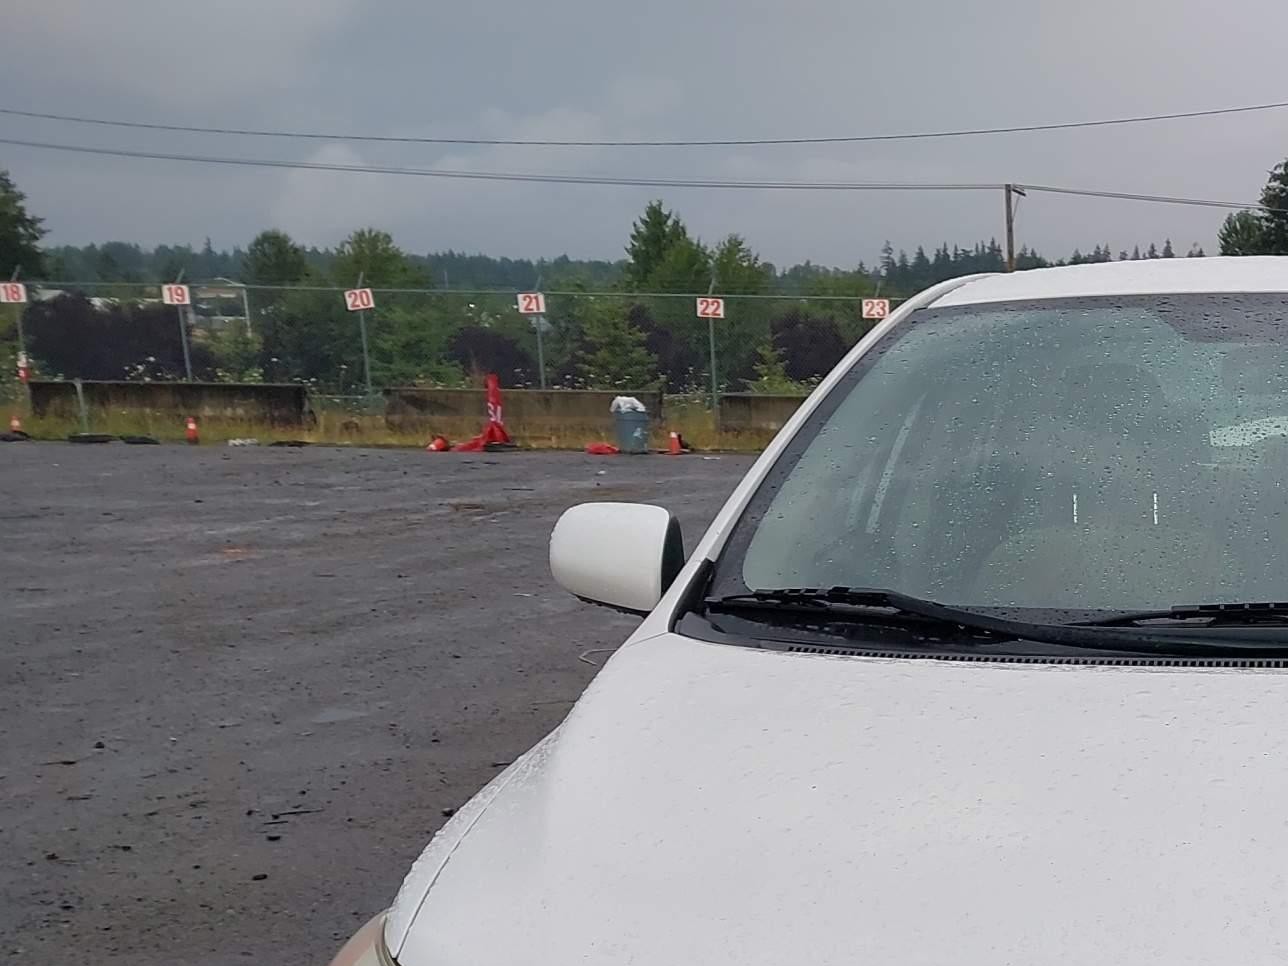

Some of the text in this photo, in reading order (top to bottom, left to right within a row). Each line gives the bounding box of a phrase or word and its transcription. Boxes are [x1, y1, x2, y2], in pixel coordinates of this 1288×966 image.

[2, 283, 22, 302] 18
[168, 286, 187, 303] 19
[350, 290, 372, 310] 20
[523, 294, 542, 313] 21
[700, 298, 721, 317] 22
[866, 299, 887, 318] 23
